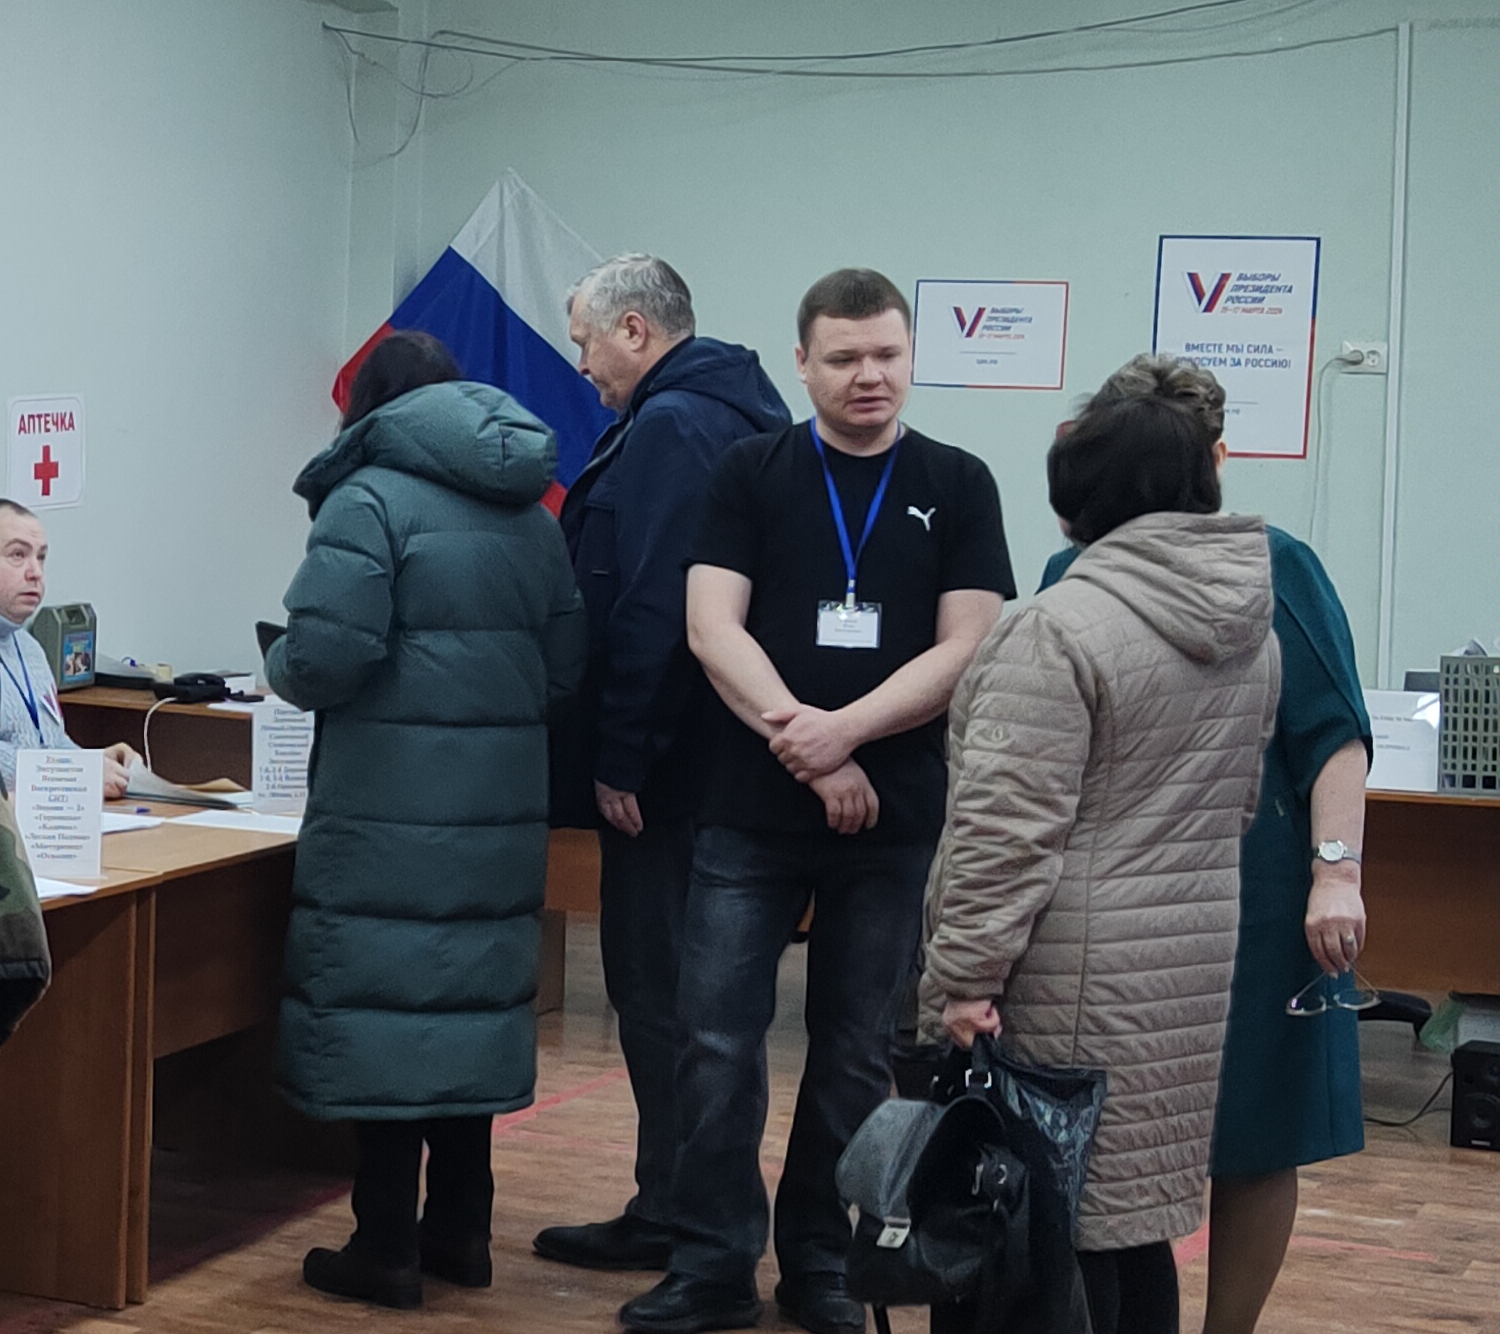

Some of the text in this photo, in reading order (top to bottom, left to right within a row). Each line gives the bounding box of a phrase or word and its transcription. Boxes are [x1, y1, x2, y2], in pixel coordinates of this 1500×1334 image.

[1236, 272, 1282, 282] ВЫБОРЫ
[1229, 284, 1294, 294] ПРЕЗИДЕНТА
[1224, 295, 1266, 304] РОССИИ
[1185, 342, 1223, 354] ВМЕСТЕ
[1226, 343, 1244, 354] МЫ
[1246, 343, 1274, 354] СИЛА
[1229, 357, 1242, 367] ЗА
[1244, 358, 1291, 369] РОССИЮ!
[18, 410, 76, 435] АПТЕЧКА
